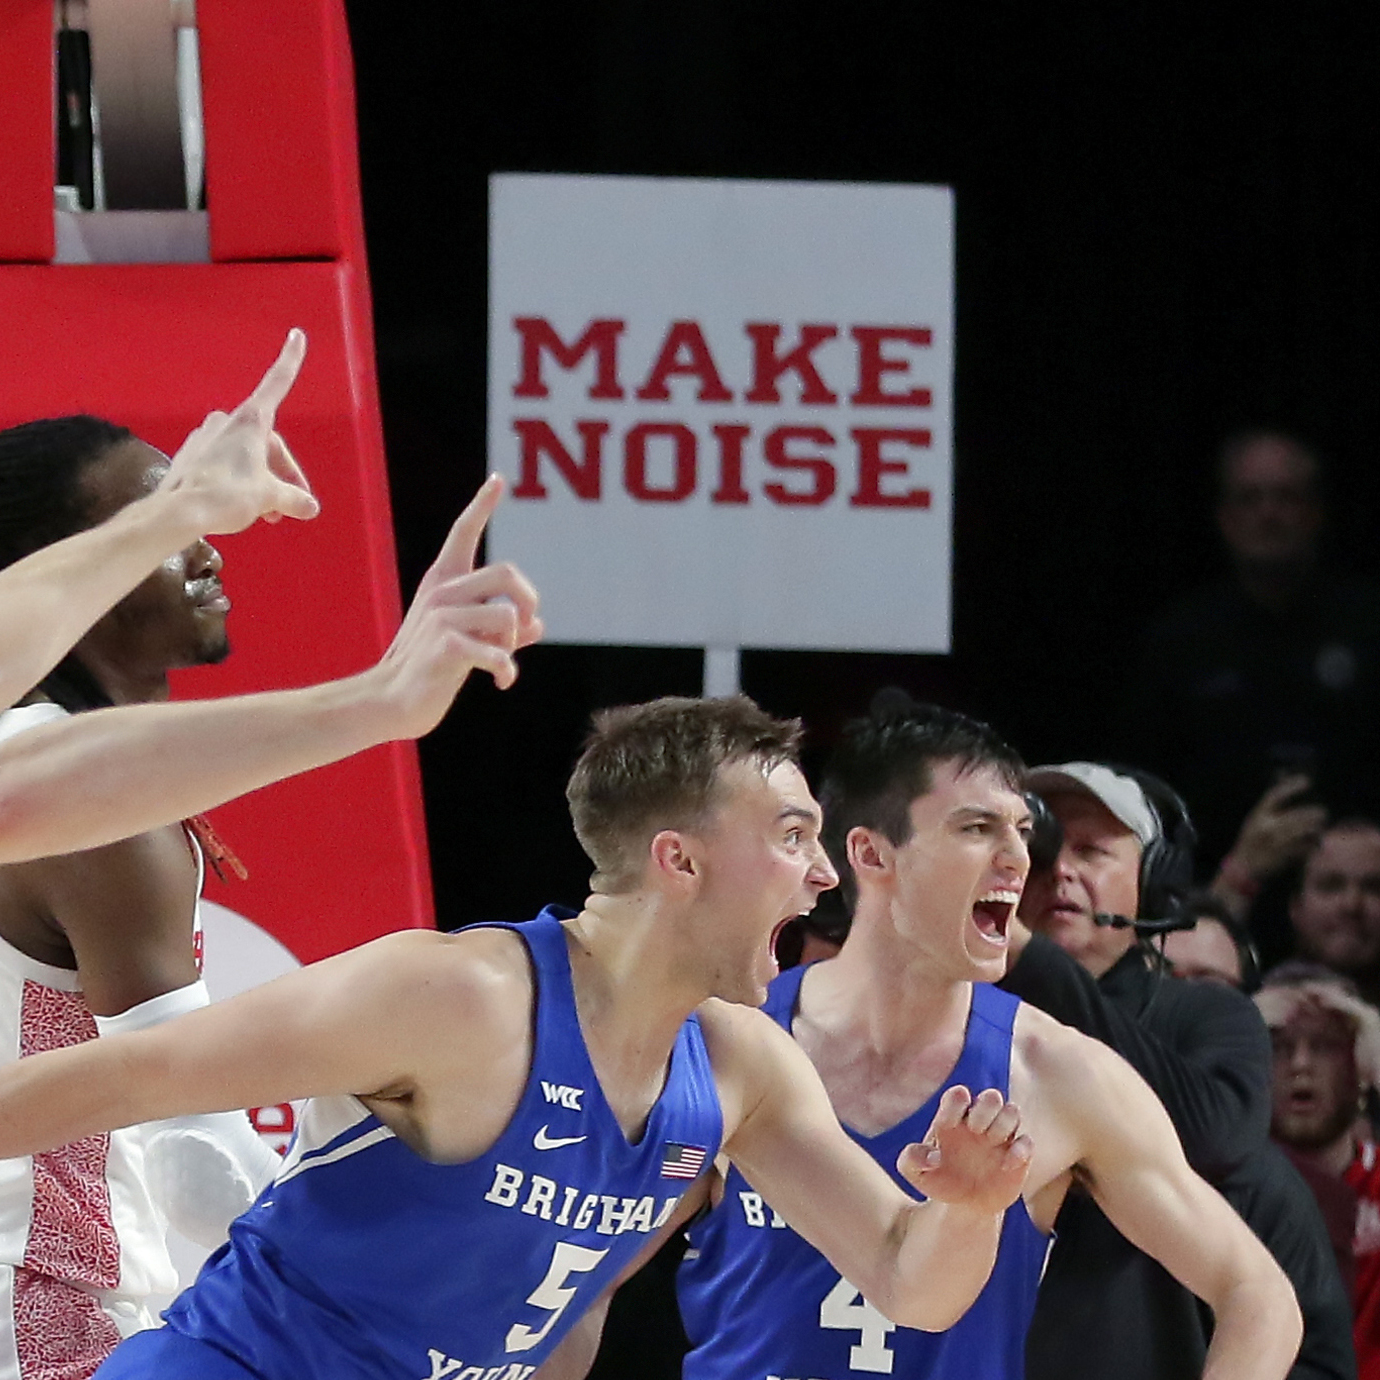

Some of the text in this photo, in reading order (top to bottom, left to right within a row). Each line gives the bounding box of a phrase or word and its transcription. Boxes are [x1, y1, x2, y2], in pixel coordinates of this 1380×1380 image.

[511, 316, 932, 405] MAKE
[511, 418, 932, 508] NOISE
[540, 1080, 585, 1111] WCC
[505, 1241, 610, 1354] 5
[820, 1276, 896, 1374] 4
